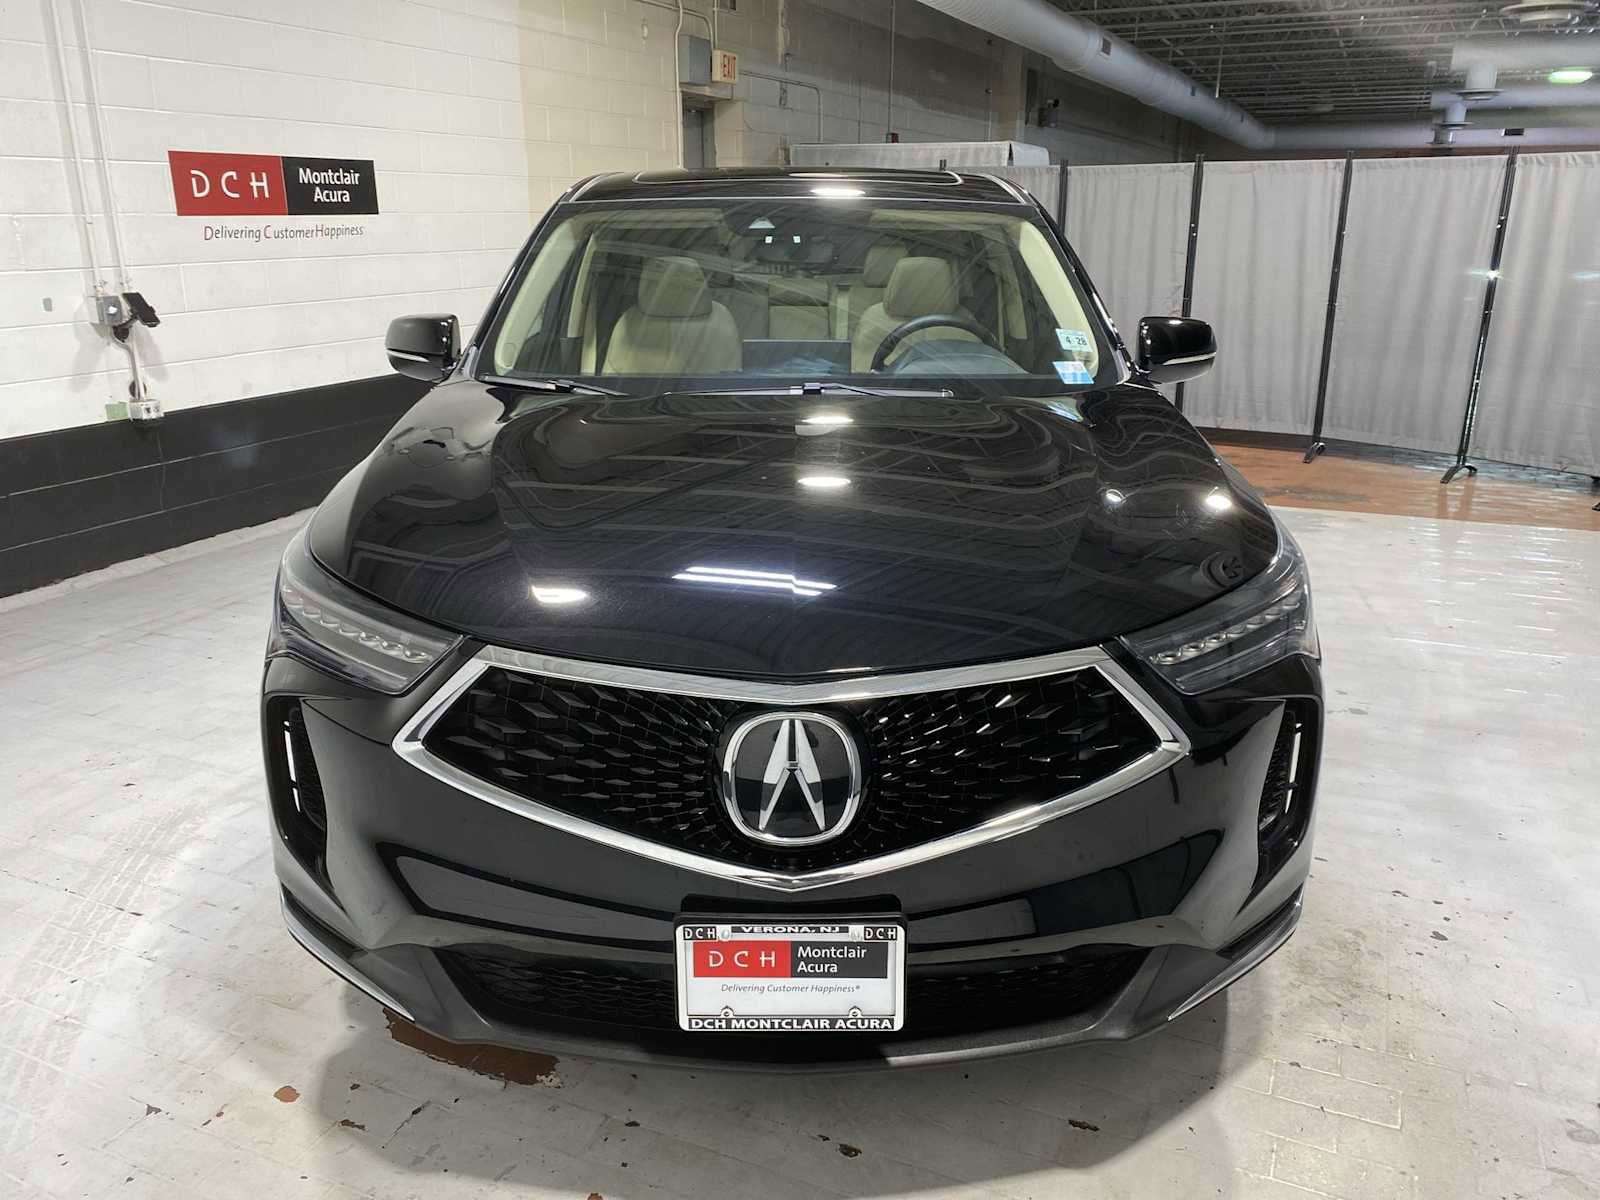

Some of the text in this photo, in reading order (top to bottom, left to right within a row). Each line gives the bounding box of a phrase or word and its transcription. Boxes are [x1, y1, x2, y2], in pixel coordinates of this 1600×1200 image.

[722, 54, 736, 80] EXIT
[299, 167, 361, 185] Montclair
[190, 169, 270, 198] DCH
[314, 187, 351, 203] Acura
[204, 225, 262, 243] Delivering
[684, 927, 717, 940] DCH
[820, 926, 840, 934] NJ
[865, 927, 898, 940] DCH
[709, 951, 775, 967] DCH
[797, 946, 867, 959] Montclair
[797, 960, 838, 974] Acura
[721, 983, 765, 994] Delivering
[767, 983, 809, 993] Customer
[691, 1018, 892, 1030] DCH MONTCLAIR ACURA
